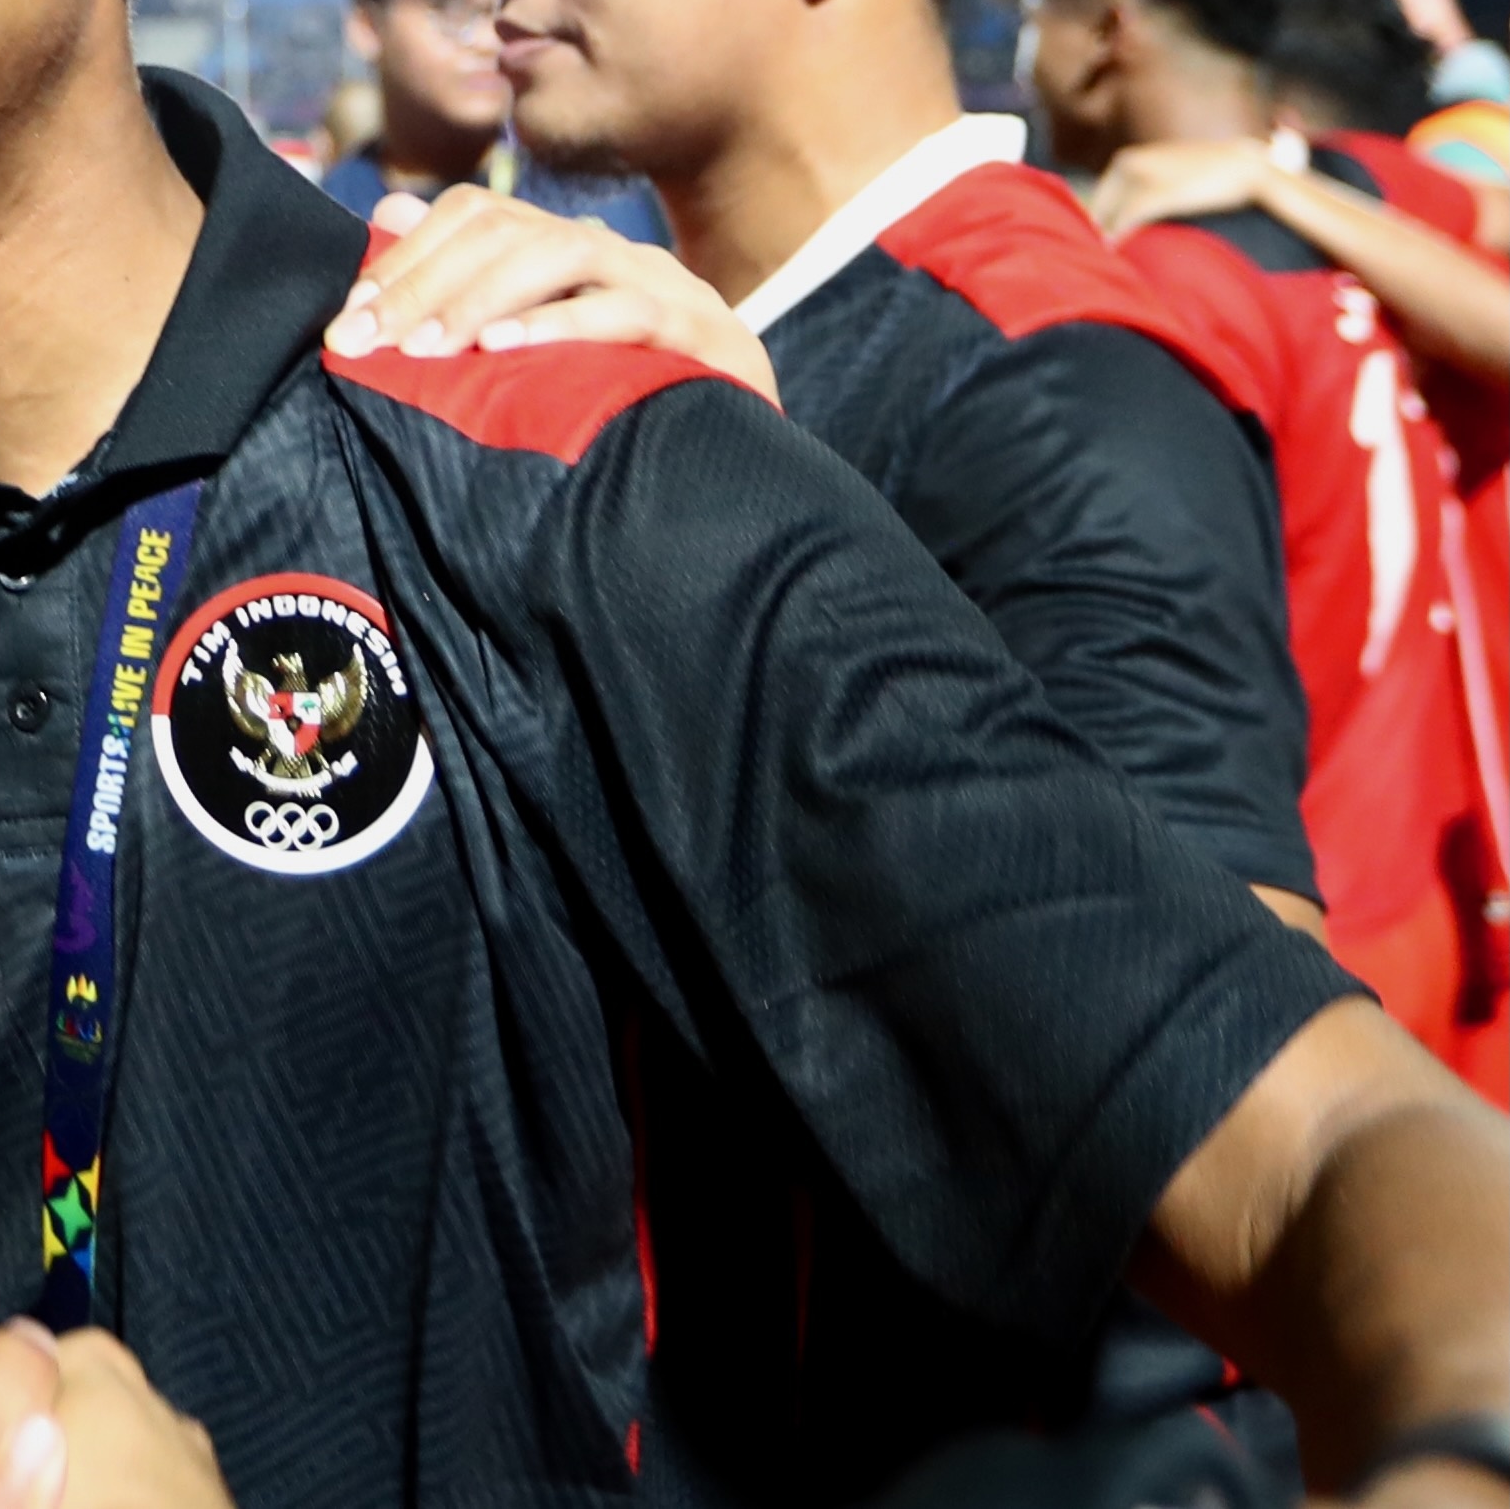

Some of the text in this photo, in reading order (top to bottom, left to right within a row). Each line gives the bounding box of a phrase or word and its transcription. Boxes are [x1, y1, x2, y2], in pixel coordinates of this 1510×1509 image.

[126, 526, 171, 621] PEACE
[119, 623, 154, 660] IN
[181, 594, 408, 696] TIM INDONESIA
